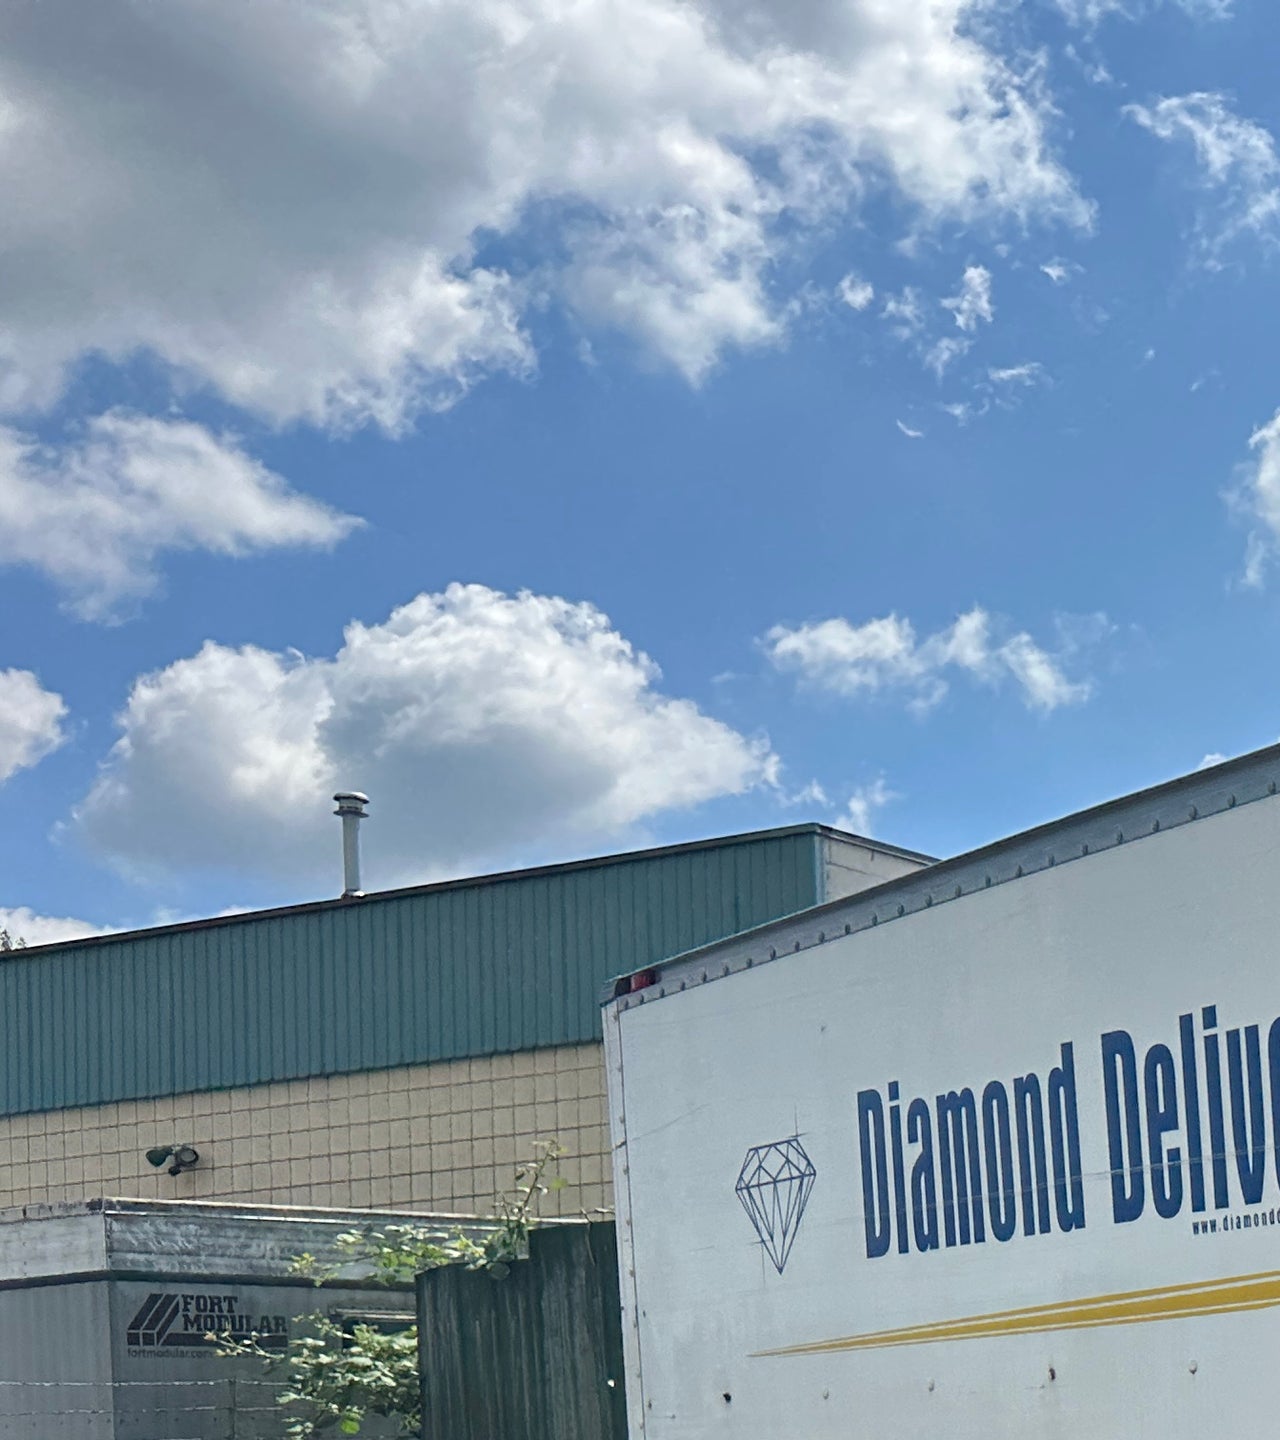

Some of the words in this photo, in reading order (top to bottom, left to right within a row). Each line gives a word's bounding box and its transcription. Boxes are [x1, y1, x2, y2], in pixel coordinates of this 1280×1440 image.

[856, 1041, 1087, 1259] Diamond
[180, 1294, 239, 1314] FORT
[182, 1314, 288, 1333] MODULAR
